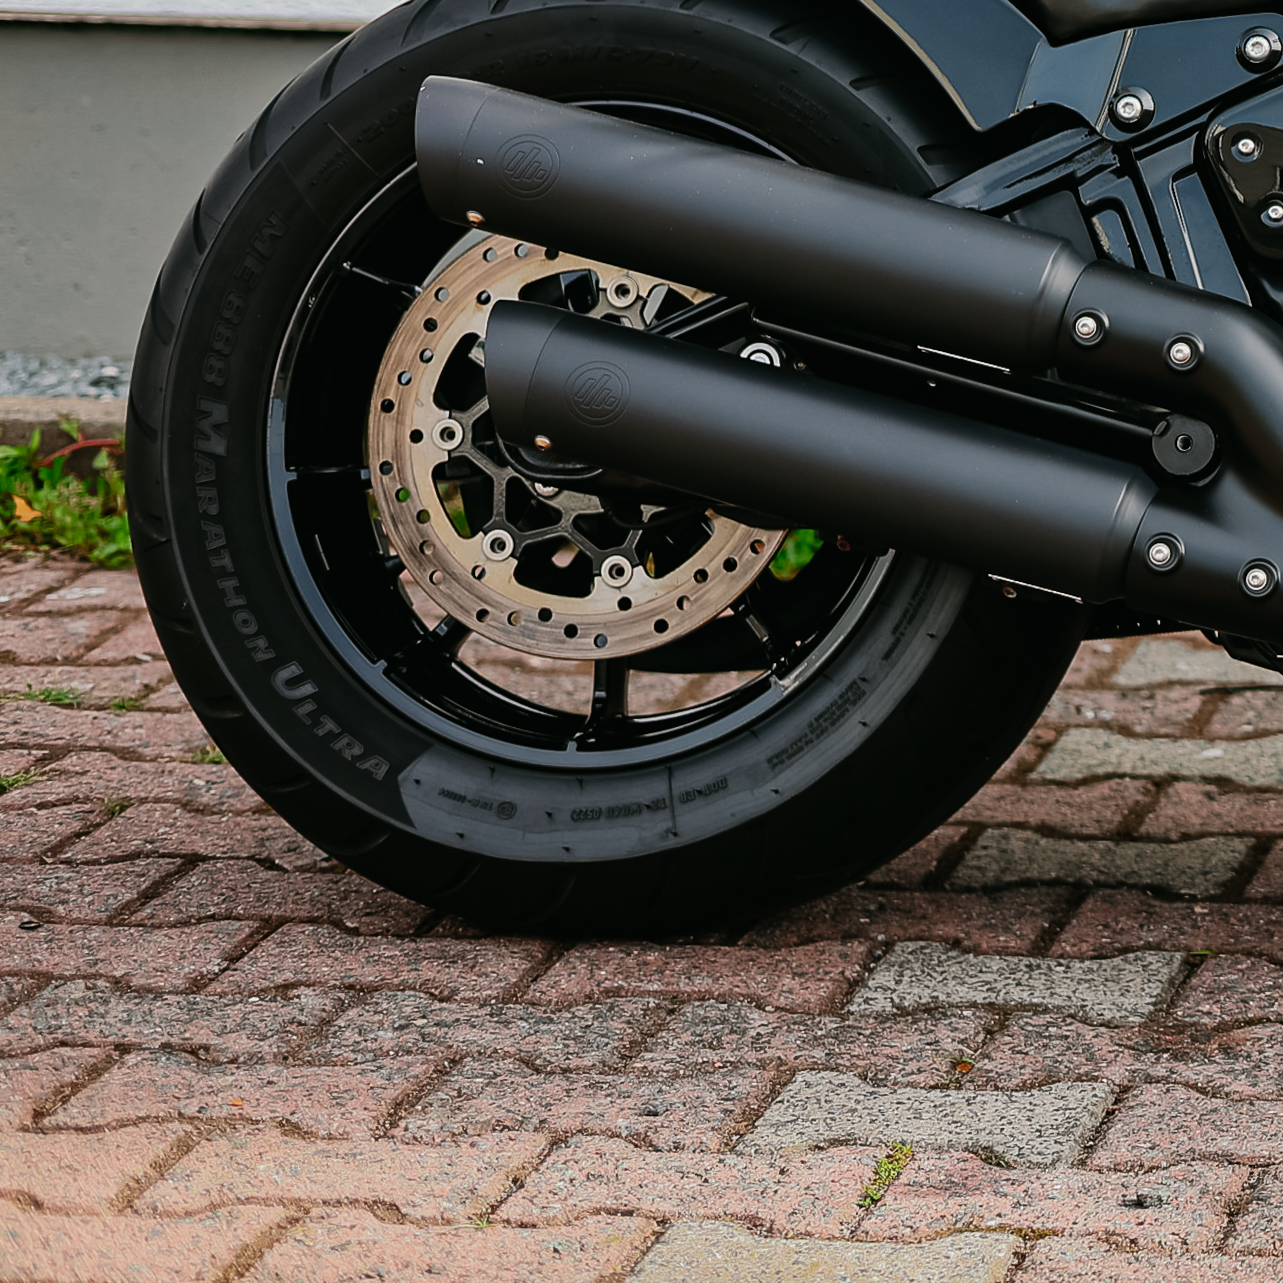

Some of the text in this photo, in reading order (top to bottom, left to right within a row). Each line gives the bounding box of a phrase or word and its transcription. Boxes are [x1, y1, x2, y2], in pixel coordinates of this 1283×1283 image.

[193, 208, 393, 783] ME 888 MARATHON ULTRA
